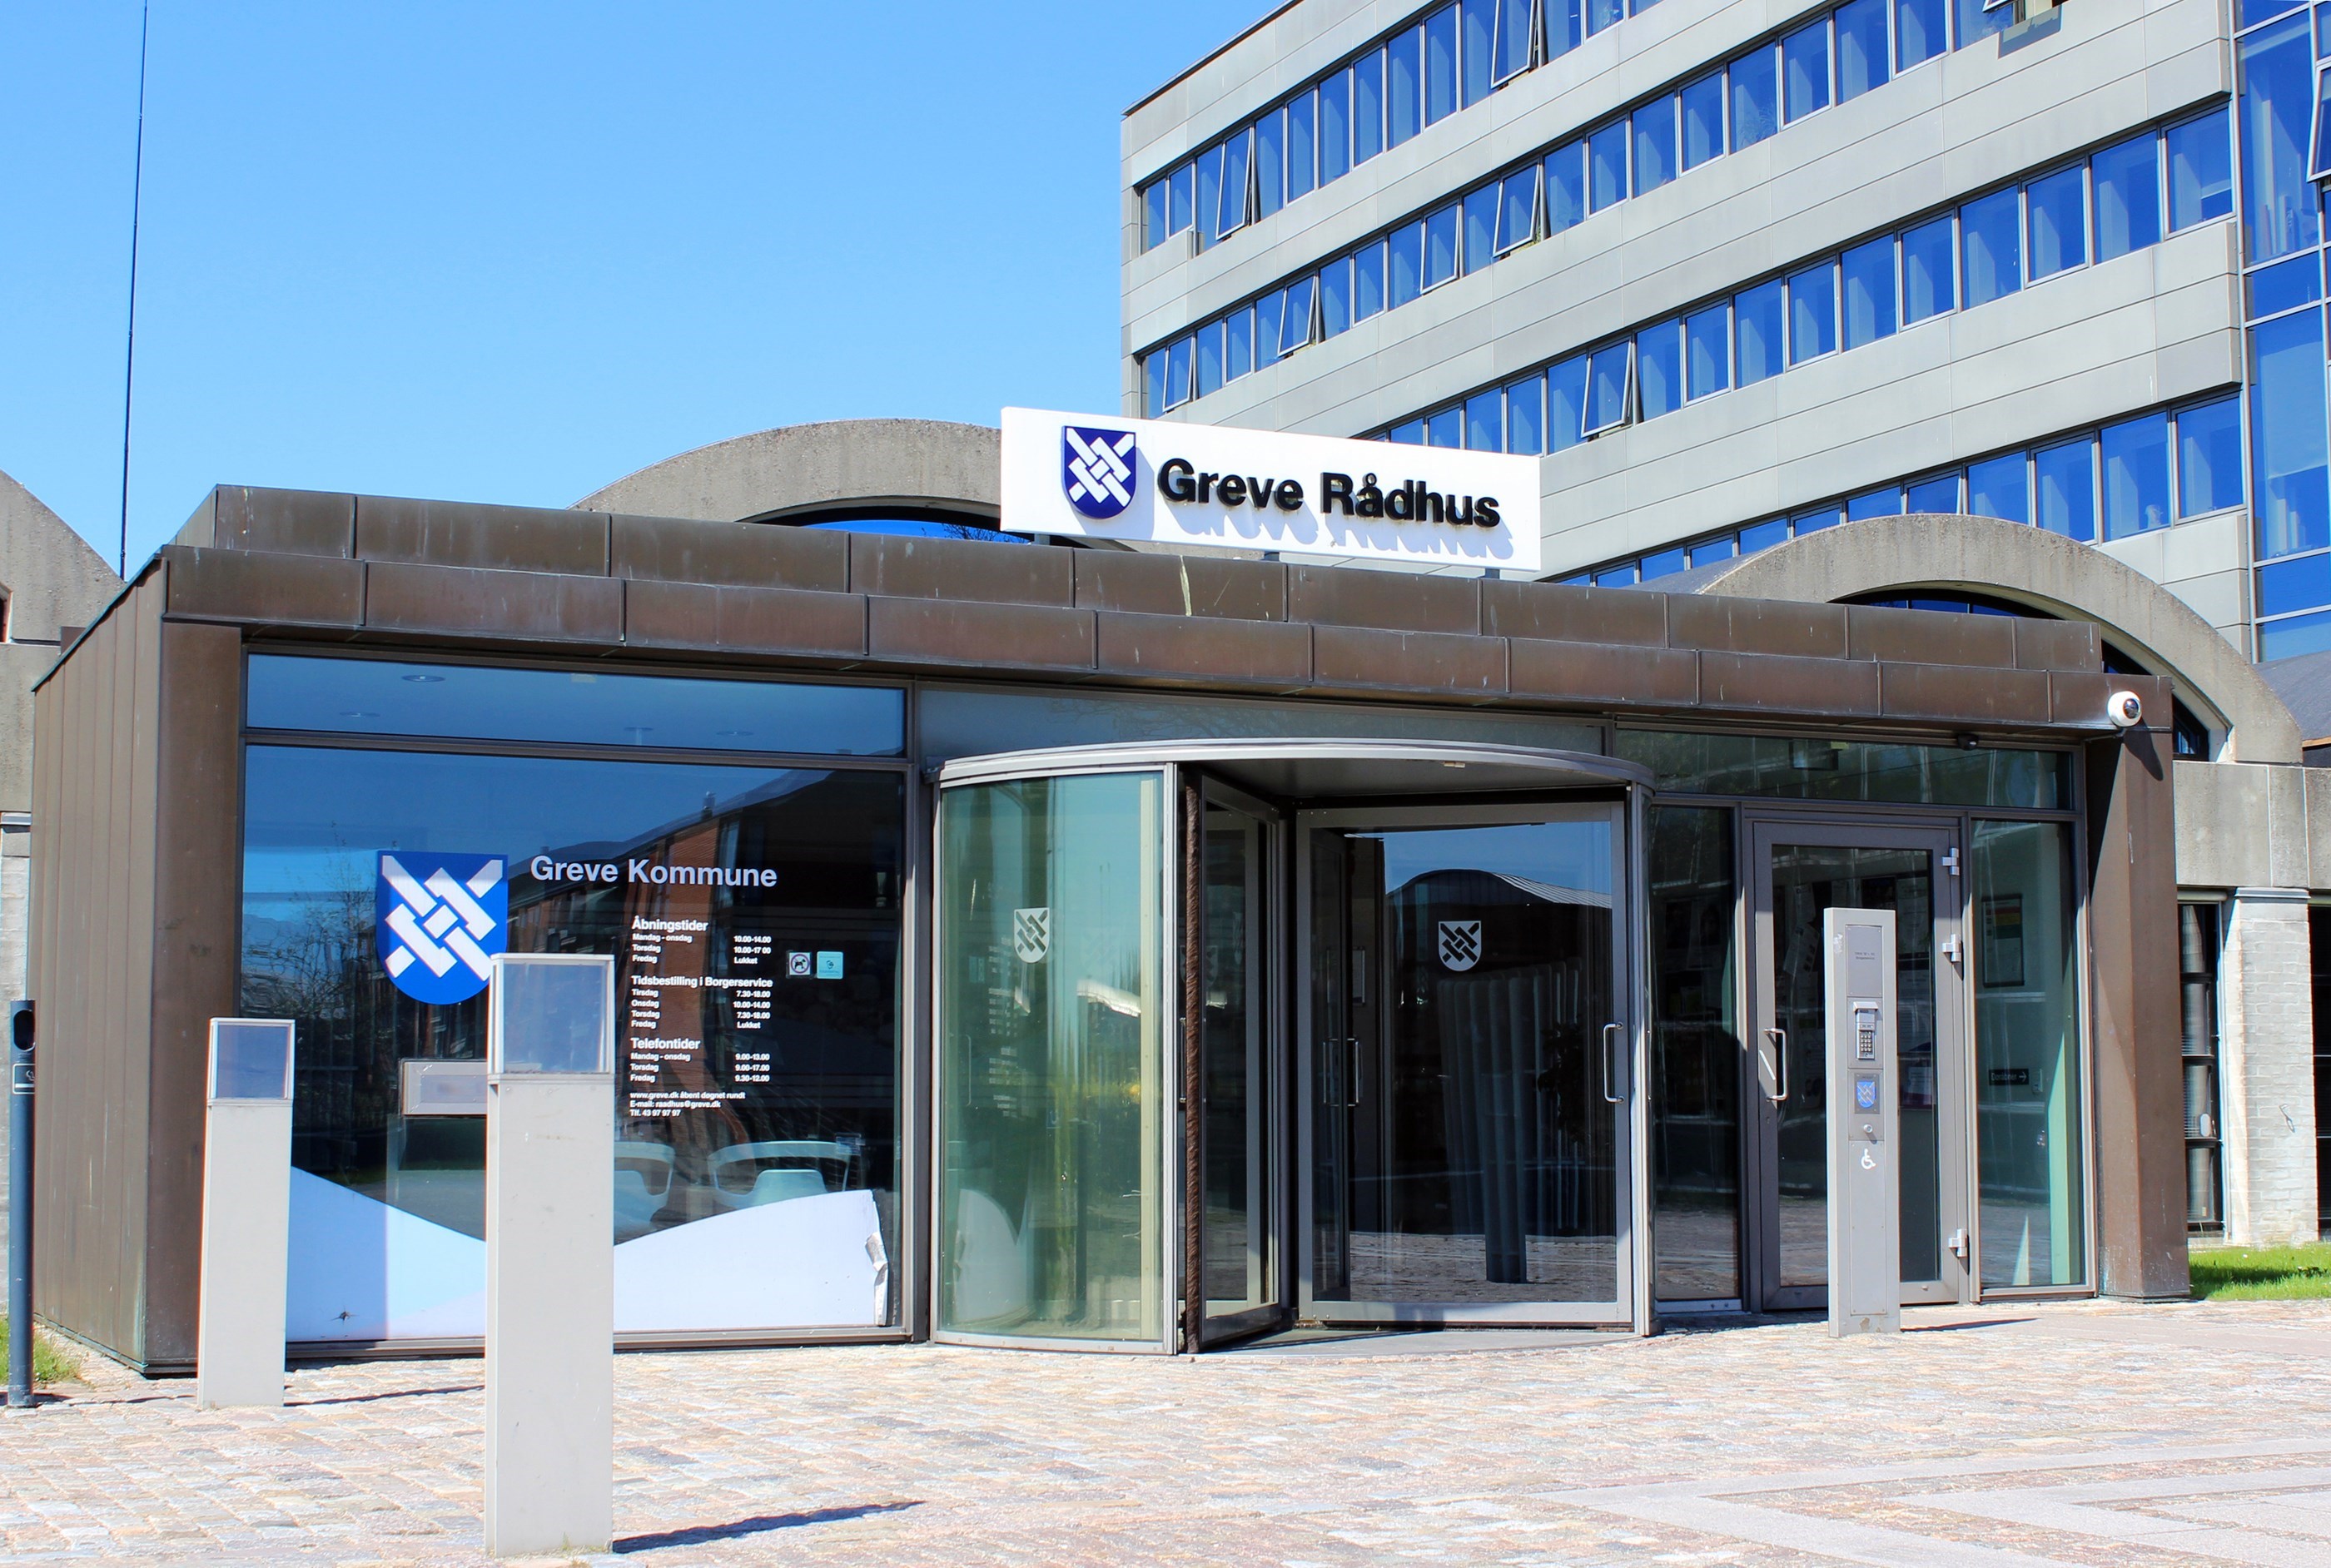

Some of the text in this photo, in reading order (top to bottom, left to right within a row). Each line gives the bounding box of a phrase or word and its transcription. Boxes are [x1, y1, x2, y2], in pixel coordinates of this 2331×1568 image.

[1157, 458, 1499, 528] Greve Rådhus
[530, 855, 778, 886] Greve Kommune
[631, 915, 708, 933] Åbningstider
[632, 933, 661, 943] Mandag
[665, 934, 693, 943] onsdag
[632, 944, 662, 954] Torsdag
[632, 955, 658, 964] Fredag
[631, 975, 773, 989] Tidsbestilling i Borgerservice
[631, 989, 659, 999] Tirsdag
[631, 1000, 660, 1009] Onsdag
[631, 1010, 661, 1020] Torsdag
[631, 1020, 657, 1030] Fredag
[630, 1037, 701, 1049] Telefontider
[630, 1053, 659, 1061] Mandag
[664, 1053, 691, 1062] onsdag
[630, 1063, 659, 1072] Torsdag
[630, 1074, 656, 1083] Fredag
[629, 1091, 679, 1099] www.greve.dk
[680, 1091, 700, 1099] åbent
[655, 1100, 721, 1109] raadhus@greve.dk
